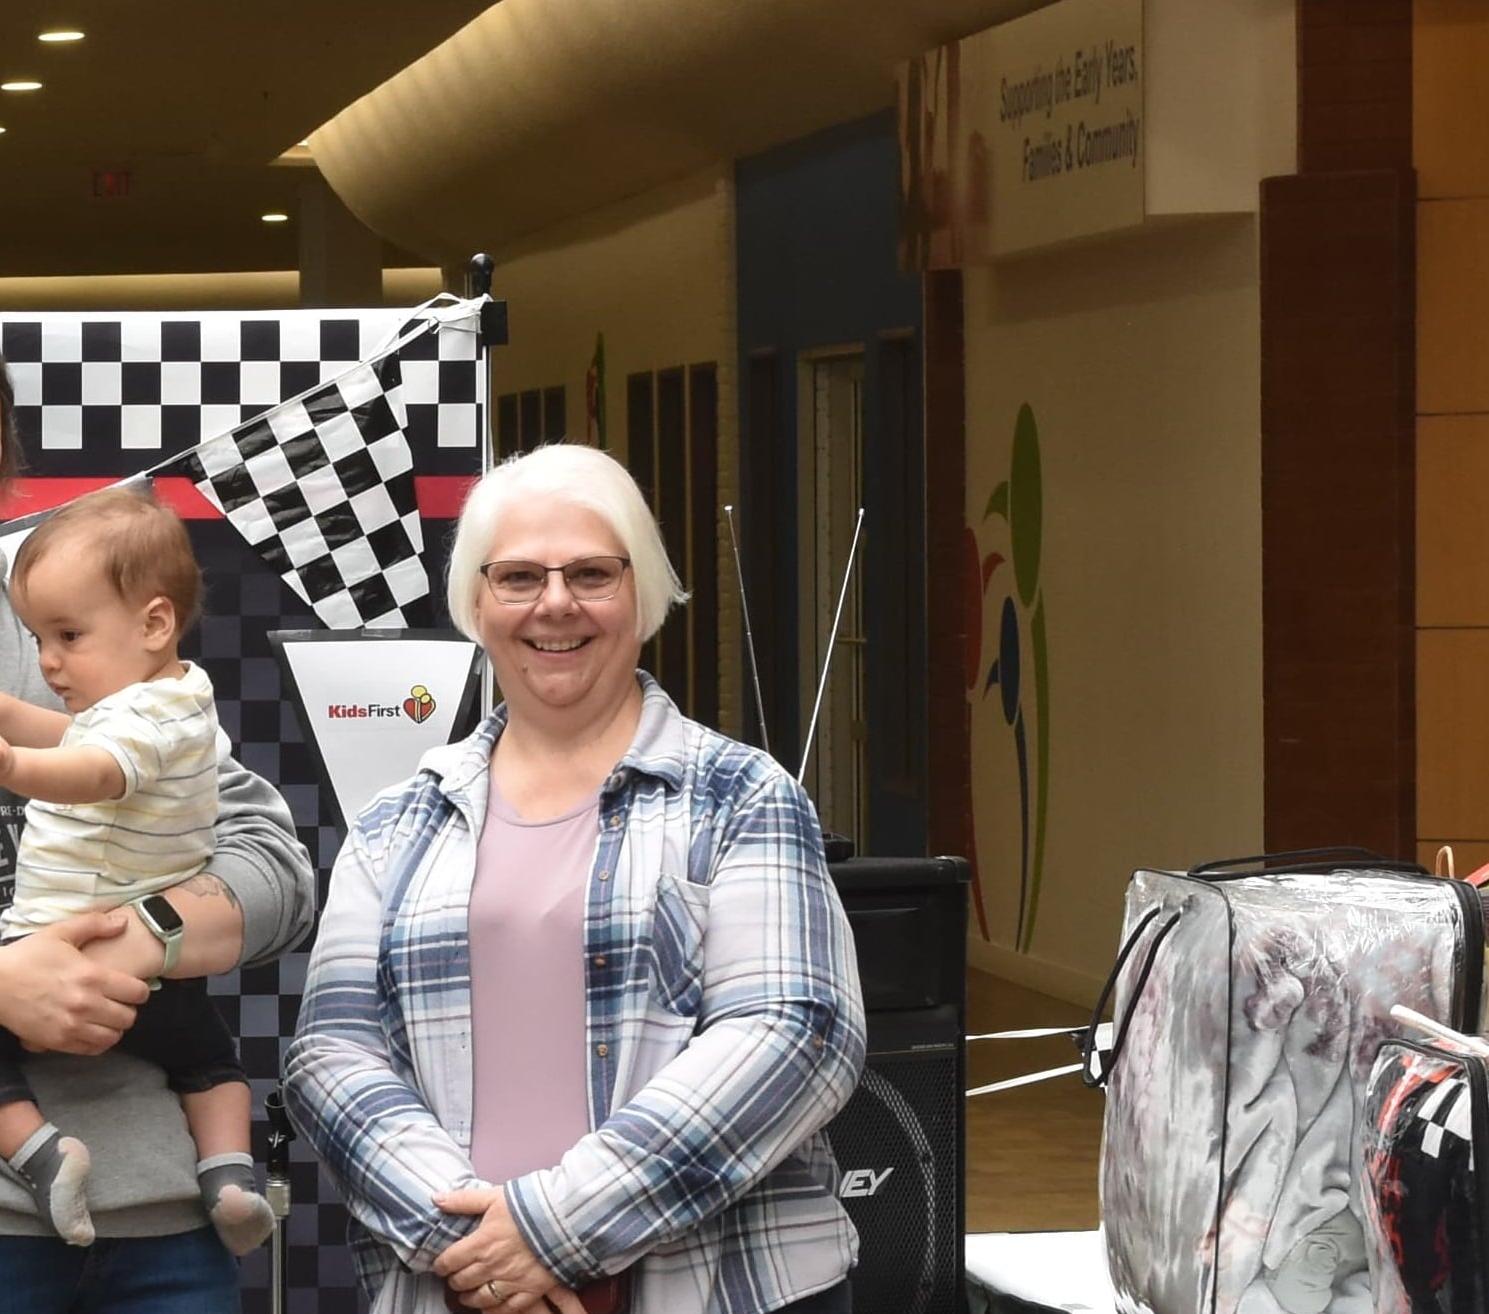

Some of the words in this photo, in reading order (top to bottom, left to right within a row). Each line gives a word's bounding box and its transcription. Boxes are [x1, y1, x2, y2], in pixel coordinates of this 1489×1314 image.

[1000, 76, 1053, 131] Supporting
[1055, 56, 1071, 104] the
[1074, 46, 1103, 104] Early
[1022, 130, 1062, 183] Families
[1065, 124, 1073, 172] &
[1077, 108, 1140, 169] Community
[328, 703, 401, 719] KidsFirst
